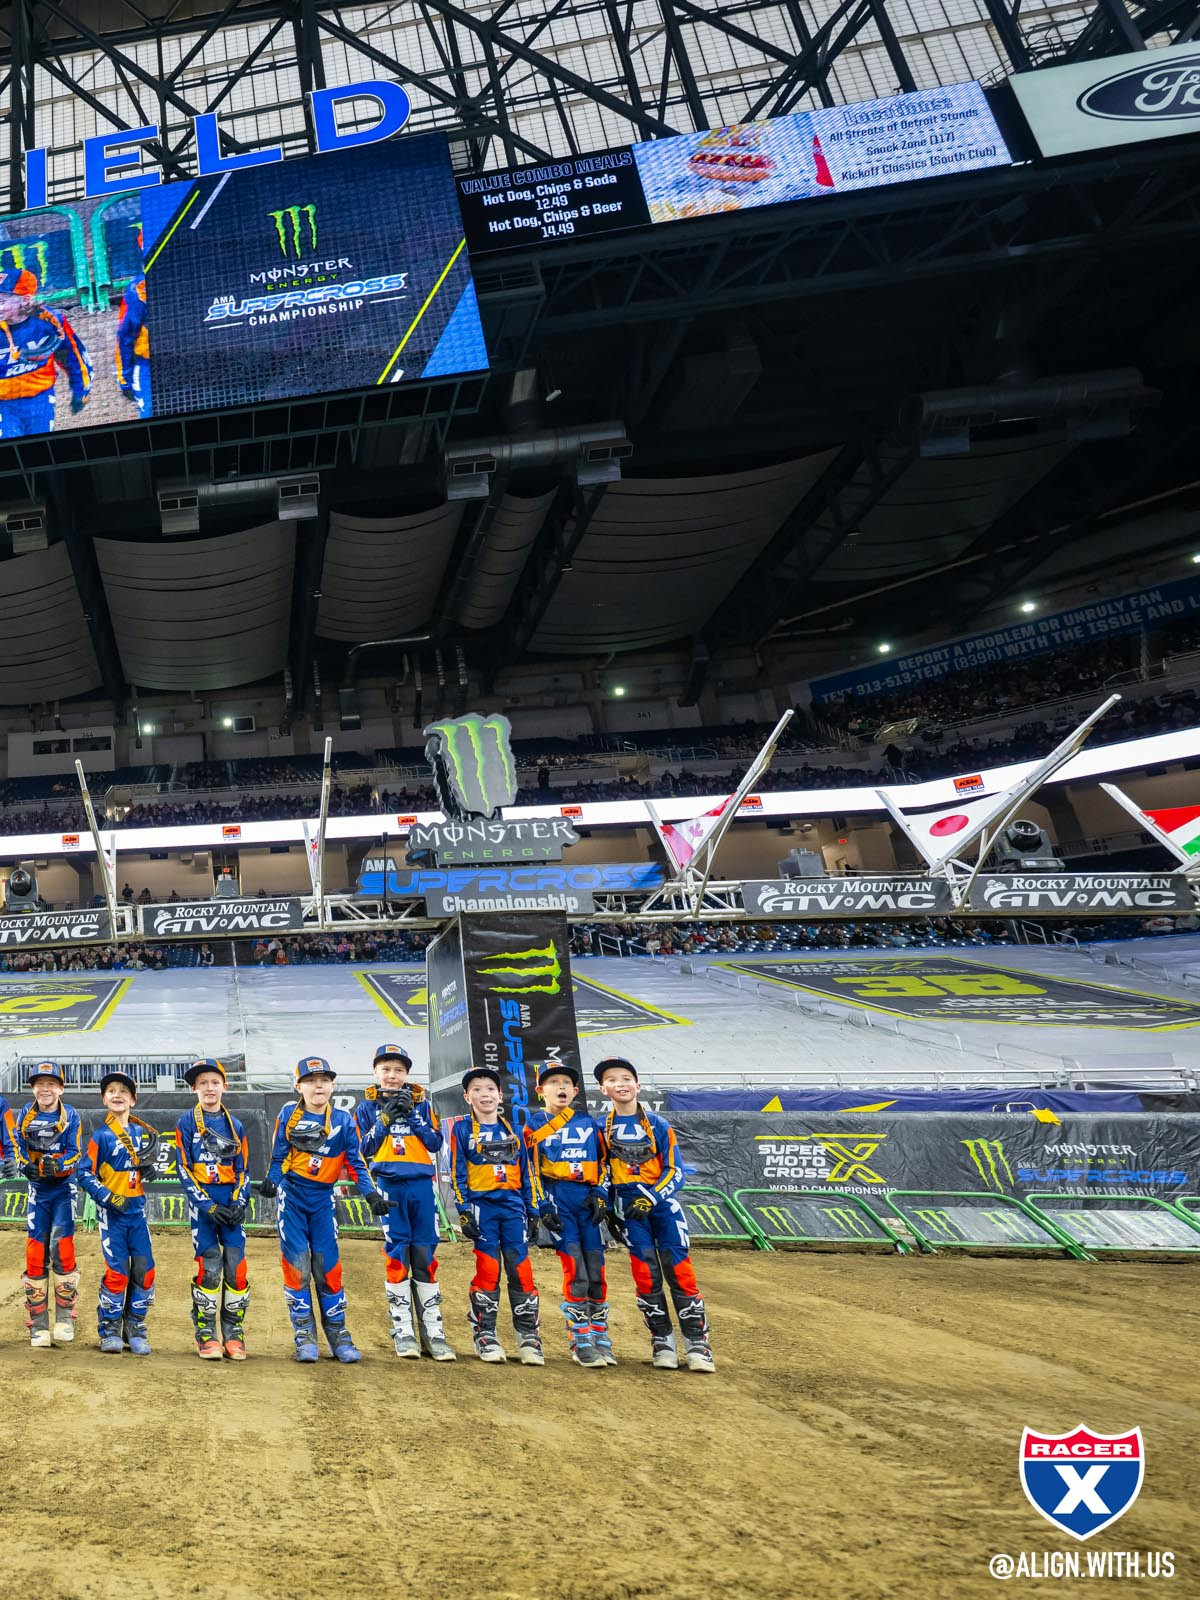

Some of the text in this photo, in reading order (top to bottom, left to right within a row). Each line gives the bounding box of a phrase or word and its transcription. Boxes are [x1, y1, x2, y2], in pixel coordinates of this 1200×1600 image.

[829, 108, 978, 143] All Streets of Detroit Stands
[866, 142, 899, 156] Snack
[901, 138, 927, 150] Zone
[460, 152, 633, 195] VALUE COMBO MEALS
[841, 166, 880, 181] Kickoff
[882, 159, 927, 174] Classics
[483, 195, 505, 206] Hot
[536, 181, 572, 197] Chips
[573, 179, 583, 190] &
[586, 174, 618, 188] Soda
[535, 195, 569, 211] 12.49
[489, 221, 511, 233] Hot
[543, 208, 579, 224] Chips
[580, 205, 591, 217] &
[592, 201, 623, 215] Beer
[541, 222, 575, 238] 14.49
[250, 257, 353, 285] MONSTER
[266, 273, 340, 291] ENERGY
[203, 272, 409, 322] SUPERCROSS
[213, 295, 235, 305] AMA
[249, 299, 364, 326] CHAMPIONSHIP
[899, 590, 1163, 672] REPORT A PROBLEM OR UNRULY FAN
[1003, 635, 1049, 657] WITH
[1051, 626, 1085, 645] THE
[1087, 610, 1144, 636] ISSUE
[1147, 599, 1185, 621] AND
[414, 820, 576, 848] MONSTER
[442, 847, 554, 861] ENERGY
[365, 859, 397, 872] AMA
[357, 863, 664, 896] SUPERCROSS
[783, 881, 933, 895] ROCKY MOUNTAIN
[1011, 875, 1173, 890] ROCKY MOUNTAIN
[175, 902, 290, 918] ROCKY MOUNTAIN
[442, 893, 579, 914] Championship
[33, 913, 99, 926] MOUNTAIN
[832, 973, 1048, 997] 38
[519, 1003, 531, 1029] AMA
[499, 997, 534, 1125] SUPERC
[390, 1124, 411, 1135] KTM
[545, 1127, 593, 1147] FLY
[604, 1124, 655, 1140] FLY
[561, 1148, 588, 1158] KTM
[758, 1144, 826, 1155] SUPER
[1044, 1142, 1138, 1157] MONSTER
[766, 1156, 826, 1167] MOTO
[763, 1167, 831, 1179] CROSS
[1017, 1169, 1189, 1184] SUPERCROSS
[660, 1182, 675, 1199] FLY
[1058, 1186, 1157, 1197] CHAMPIONSHIP
